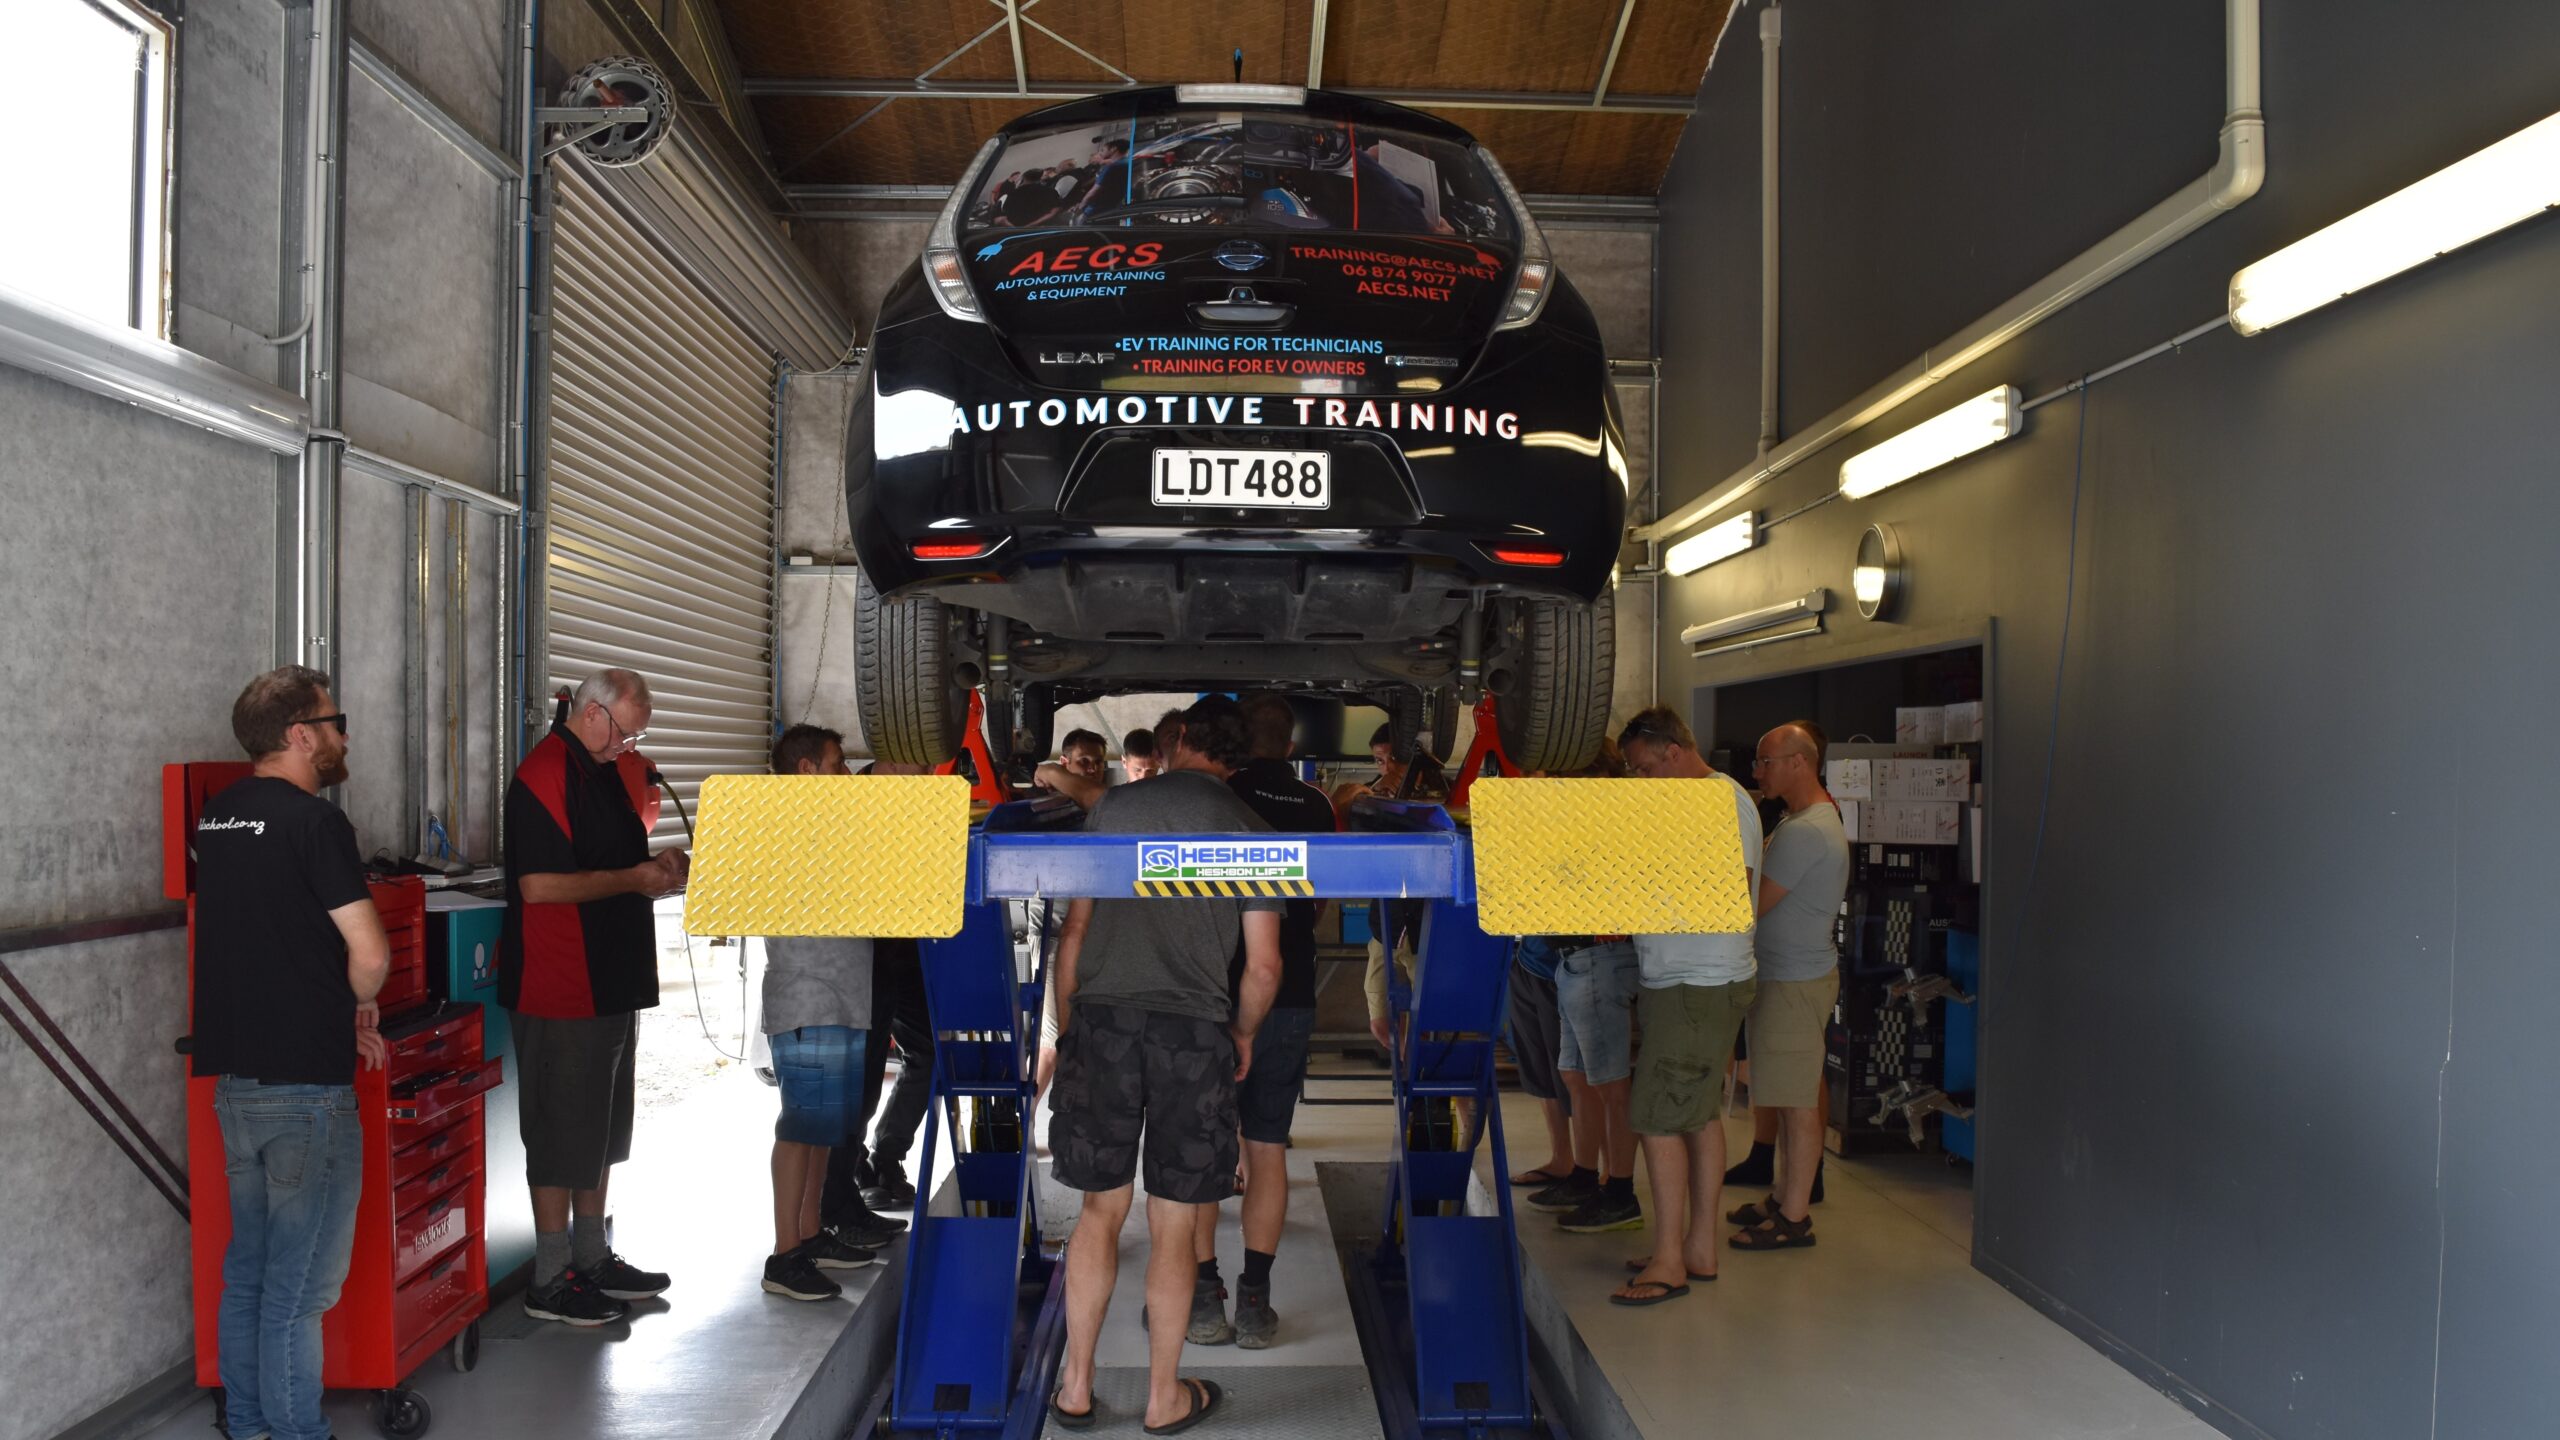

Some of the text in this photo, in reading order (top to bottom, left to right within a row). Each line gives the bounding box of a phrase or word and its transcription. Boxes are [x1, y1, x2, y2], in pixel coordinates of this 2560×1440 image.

[1009, 242, 1163, 276] AECS
[1290, 246, 1496, 281] TRAINING@AECS.NET
[994, 271, 1166, 291] AUTOMOTIVE TRAINING
[1342, 264, 1457, 286] 06 874 9077
[1027, 286, 1127, 301] & EQUIPMENT
[1356, 280, 1451, 302] AECS.NET
[1122, 337, 1383, 354] EV TRAINING FOR TECHNICIANS
[1039, 351, 1116, 364] LEAF
[1142, 359, 1224, 373] TRAINING
[1229, 359, 1262, 374] FOR
[1292, 360, 1366, 375] OWNERS
[950, 396, 1520, 439] AUTOMOTIVE TRAINING
[1161, 457, 1323, 498] LDT488
[1181, 847, 1299, 863] HESHBON
[1196, 867, 1287, 877] HESHBON LIFT
